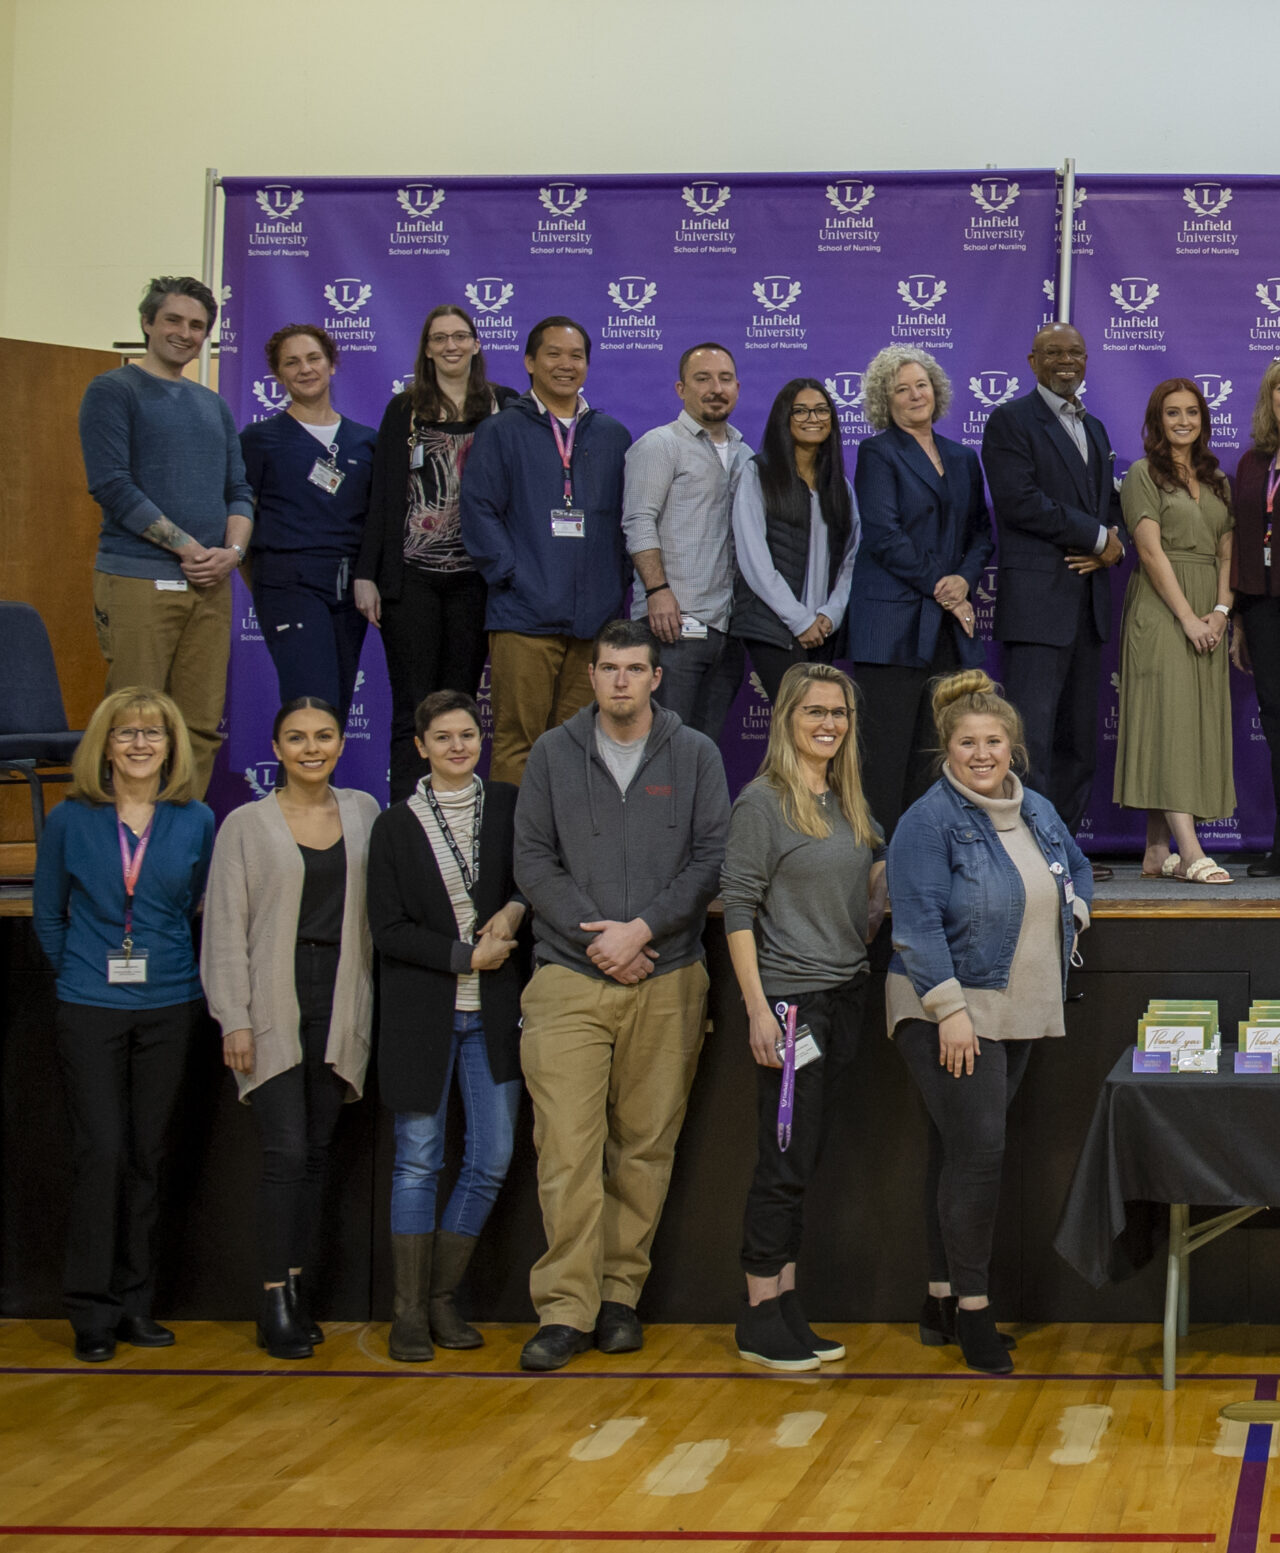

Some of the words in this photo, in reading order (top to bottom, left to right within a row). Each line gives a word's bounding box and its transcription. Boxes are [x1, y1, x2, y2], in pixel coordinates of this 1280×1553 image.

[415, 191, 427, 206] L
[557, 190, 569, 205] L
[700, 189, 712, 204] L
[844, 187, 856, 202] L
[989, 186, 1002, 201] L
[1202, 190, 1214, 205] L
[274, 192, 286, 207] L
[397, 221, 443, 232] Linfield
[539, 220, 585, 230] Linfield
[682, 219, 729, 229] Linfield
[826, 217, 873, 228] Linfield
[971, 216, 1018, 227] Linfield
[1184, 220, 1231, 231] Linfield
[256, 222, 302, 233] Linfield
[250, 234, 307, 246] University
[391, 233, 448, 245] University
[532, 232, 591, 244] University
[676, 231, 735, 243] University
[820, 230, 879, 242] University
[965, 229, 1024, 241] University
[1178, 232, 1237, 245] University
[248, 249, 272, 257] School
[273, 249, 281, 257] of
[282, 249, 309, 258] Nursing
[389, 248, 413, 256] School
[414, 248, 422, 256] of
[423, 248, 450, 257] Nursing
[531, 247, 555, 255] School
[556, 247, 564, 255] of
[565, 247, 592, 256] Nursing
[674, 246, 698, 254] School
[699, 246, 707, 254] of
[708, 246, 736, 255] Nursing
[853, 245, 881, 253] Nursing
[998, 244, 1026, 252] Nursing
[1211, 248, 1239, 256] Nursing
[342, 287, 354, 302] L
[484, 285, 496, 301] L
[626, 285, 638, 300] L
[771, 285, 784, 300] L
[916, 284, 928, 299] L
[1129, 287, 1142, 302] L
[325, 317, 370, 328] Linfield
[473, 316, 512, 327] infield
[608, 315, 655, 326] Linfield
[753, 315, 800, 325] Linfield
[898, 314, 945, 324] Linfield
[1111, 317, 1158, 327] Linfield
[602, 328, 661, 340] University
[747, 327, 806, 339] University
[892, 326, 952, 338] University
[1105, 329, 1164, 341] University
[350, 344, 377, 352] Nursing
[492, 344, 519, 352] Nursing
[635, 343, 663, 351] Nursing
[745, 342, 769, 350] School
[770, 342, 778, 350] of
[779, 342, 807, 351] Nursing
[925, 342, 953, 350] Nursing
[1103, 344, 1128, 352] School
[1129, 344, 1137, 352] of
[1138, 344, 1166, 353] Nursing
[1249, 344, 1274, 352] School
[843, 381, 856, 396] L
[1203, 382, 1215, 398] L
[1148, 1028, 1185, 1048] Thank
